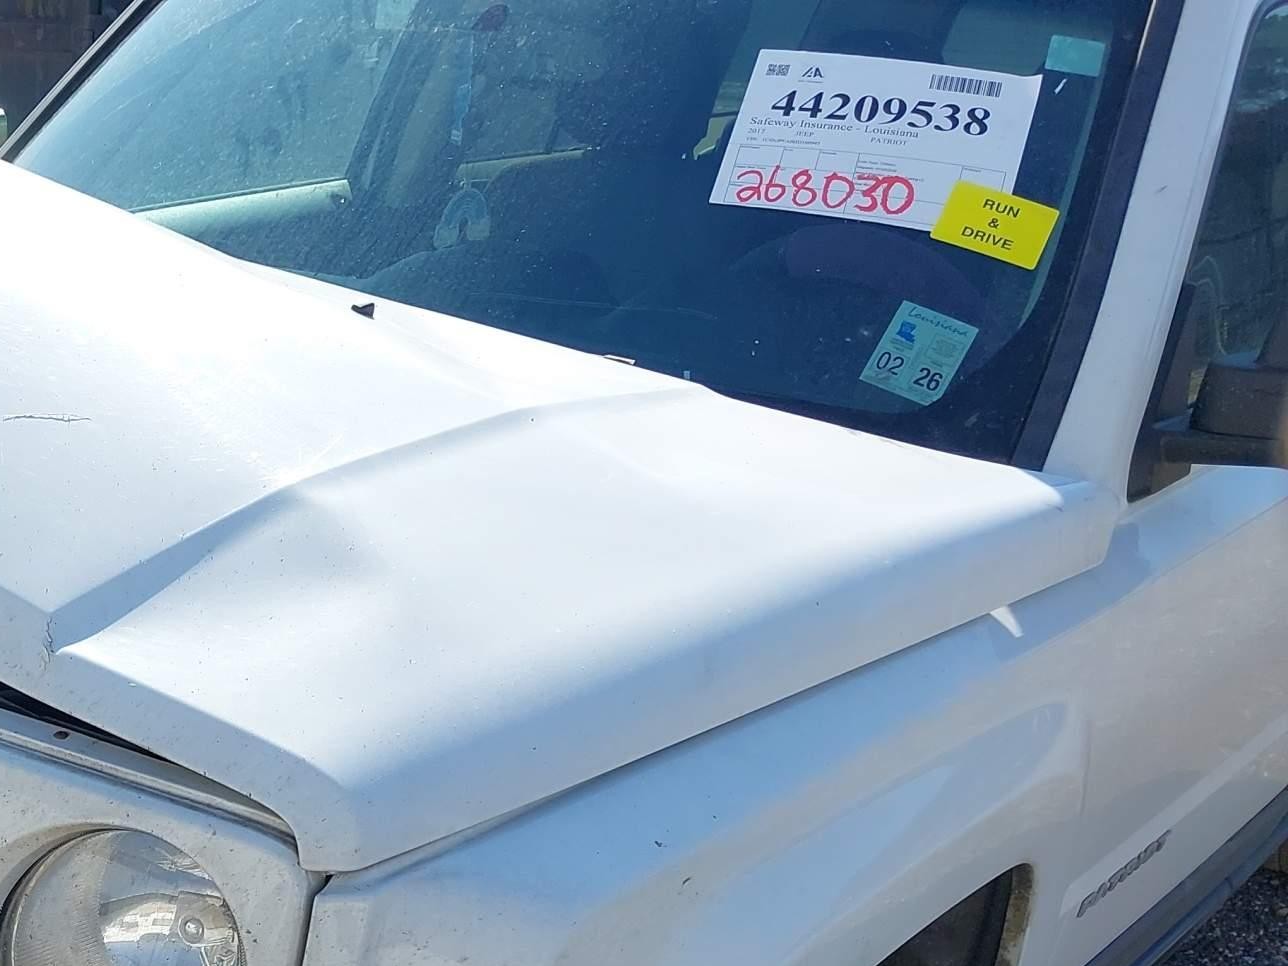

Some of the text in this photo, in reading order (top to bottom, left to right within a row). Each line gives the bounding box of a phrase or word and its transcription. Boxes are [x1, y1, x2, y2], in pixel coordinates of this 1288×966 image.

[770, 89, 992, 136] 44209538
[749, 116, 796, 129] Safeway
[800, 119, 854, 132] Insurance
[864, 124, 919, 138] Louisiana
[870, 136, 908, 146] PATRIOT
[736, 164, 915, 215] 268030
[982, 198, 1021, 218] RUN
[988, 217, 1000, 229] &
[961, 226, 1015, 251] DRIVE
[907, 306, 969, 338] Louisiana
[876, 351, 944, 392] 02 26
